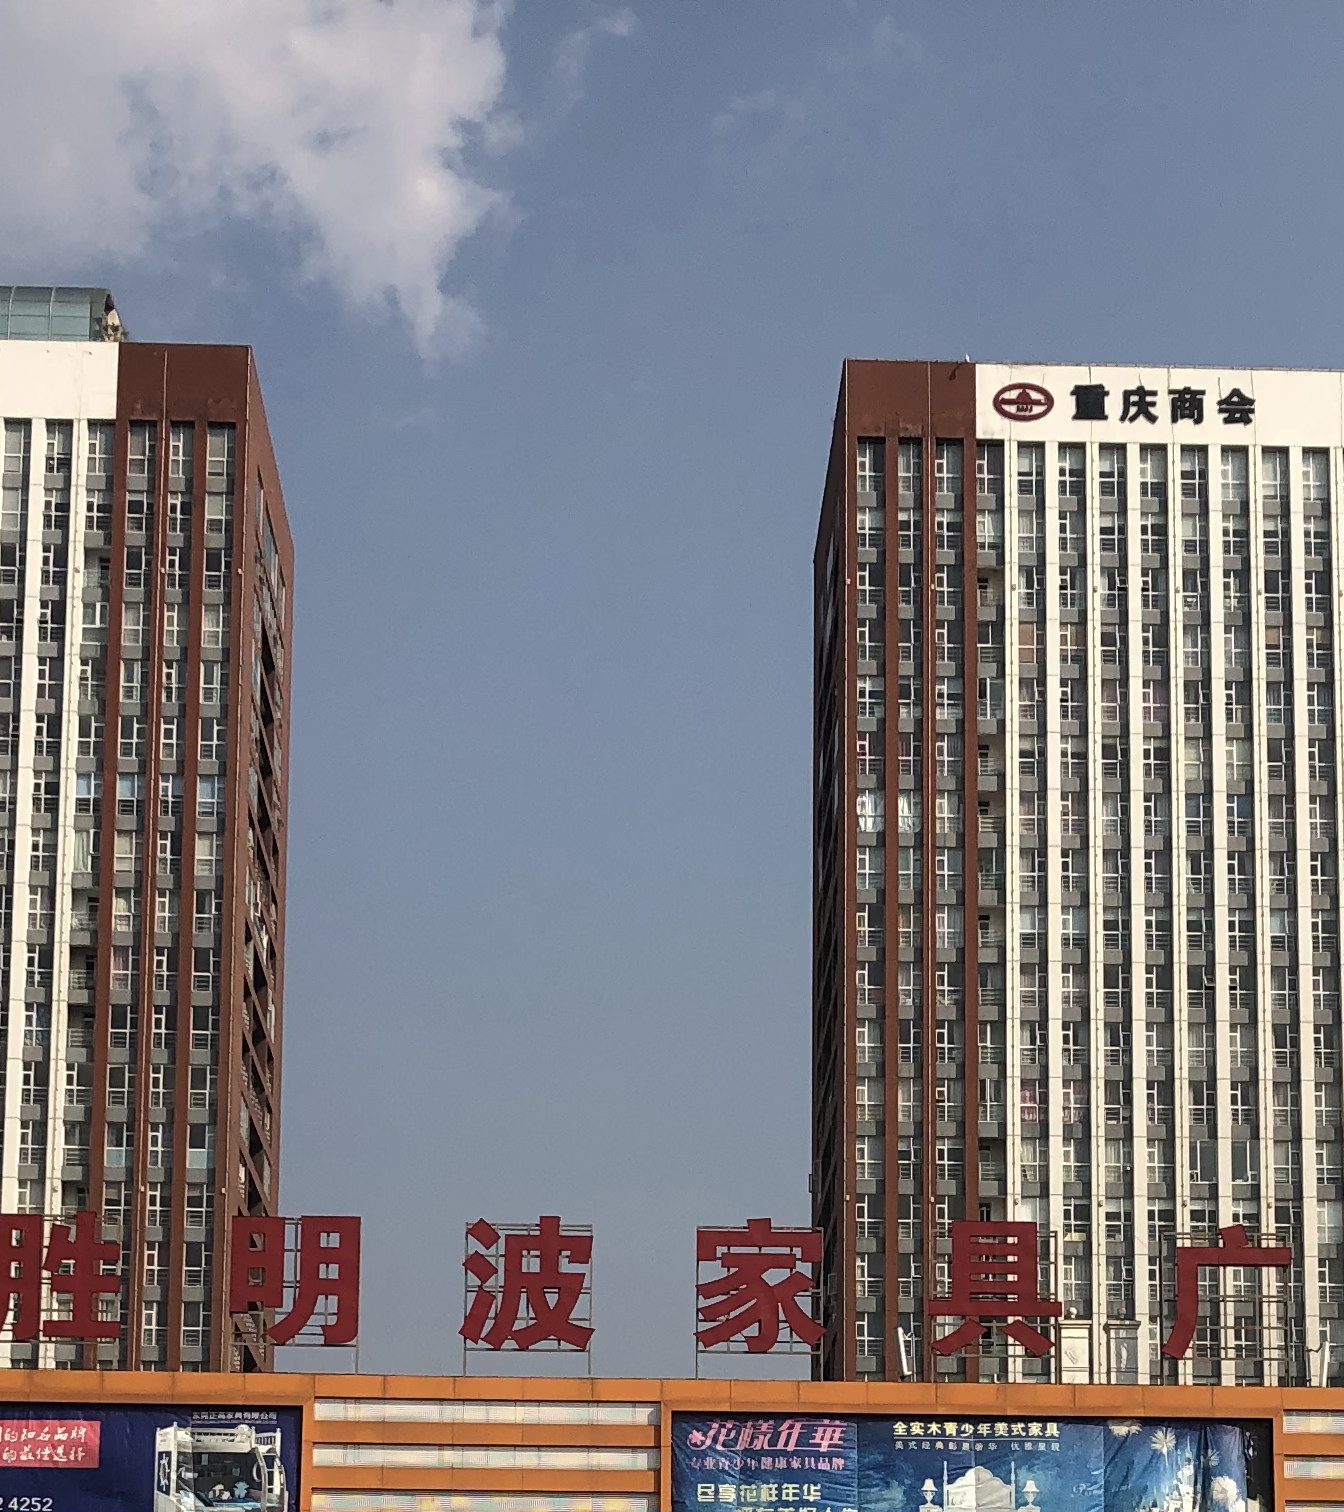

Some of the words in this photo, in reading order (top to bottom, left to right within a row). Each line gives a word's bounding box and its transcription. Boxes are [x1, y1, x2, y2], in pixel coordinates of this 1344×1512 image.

[1069, 383, 1257, 426] 重庆商会
[892, 1421, 1060, 1438] 全实木青少年美式家具
[8, 1497, 53, 1512] 4252
